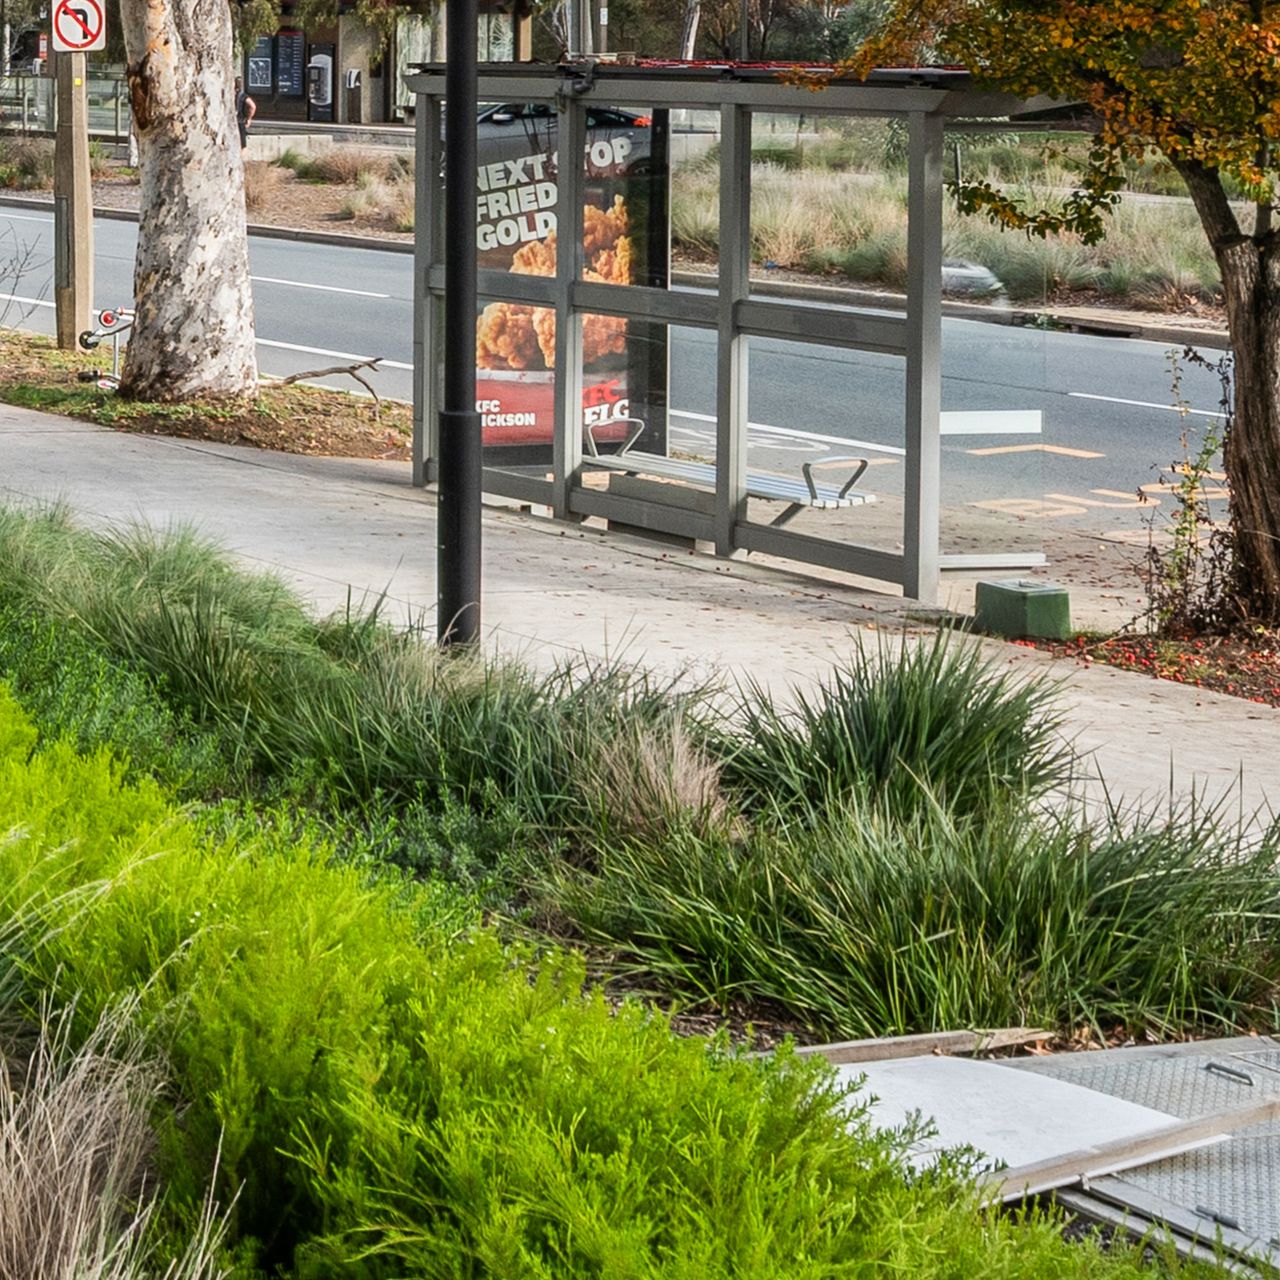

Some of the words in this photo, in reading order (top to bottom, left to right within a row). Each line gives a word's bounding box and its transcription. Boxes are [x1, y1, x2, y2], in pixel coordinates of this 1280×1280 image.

[476, 152, 547, 192] NEXT
[476, 181, 558, 223] FRIED
[476, 211, 558, 251] GOLD
[481, 412, 536, 427] ICKSON
